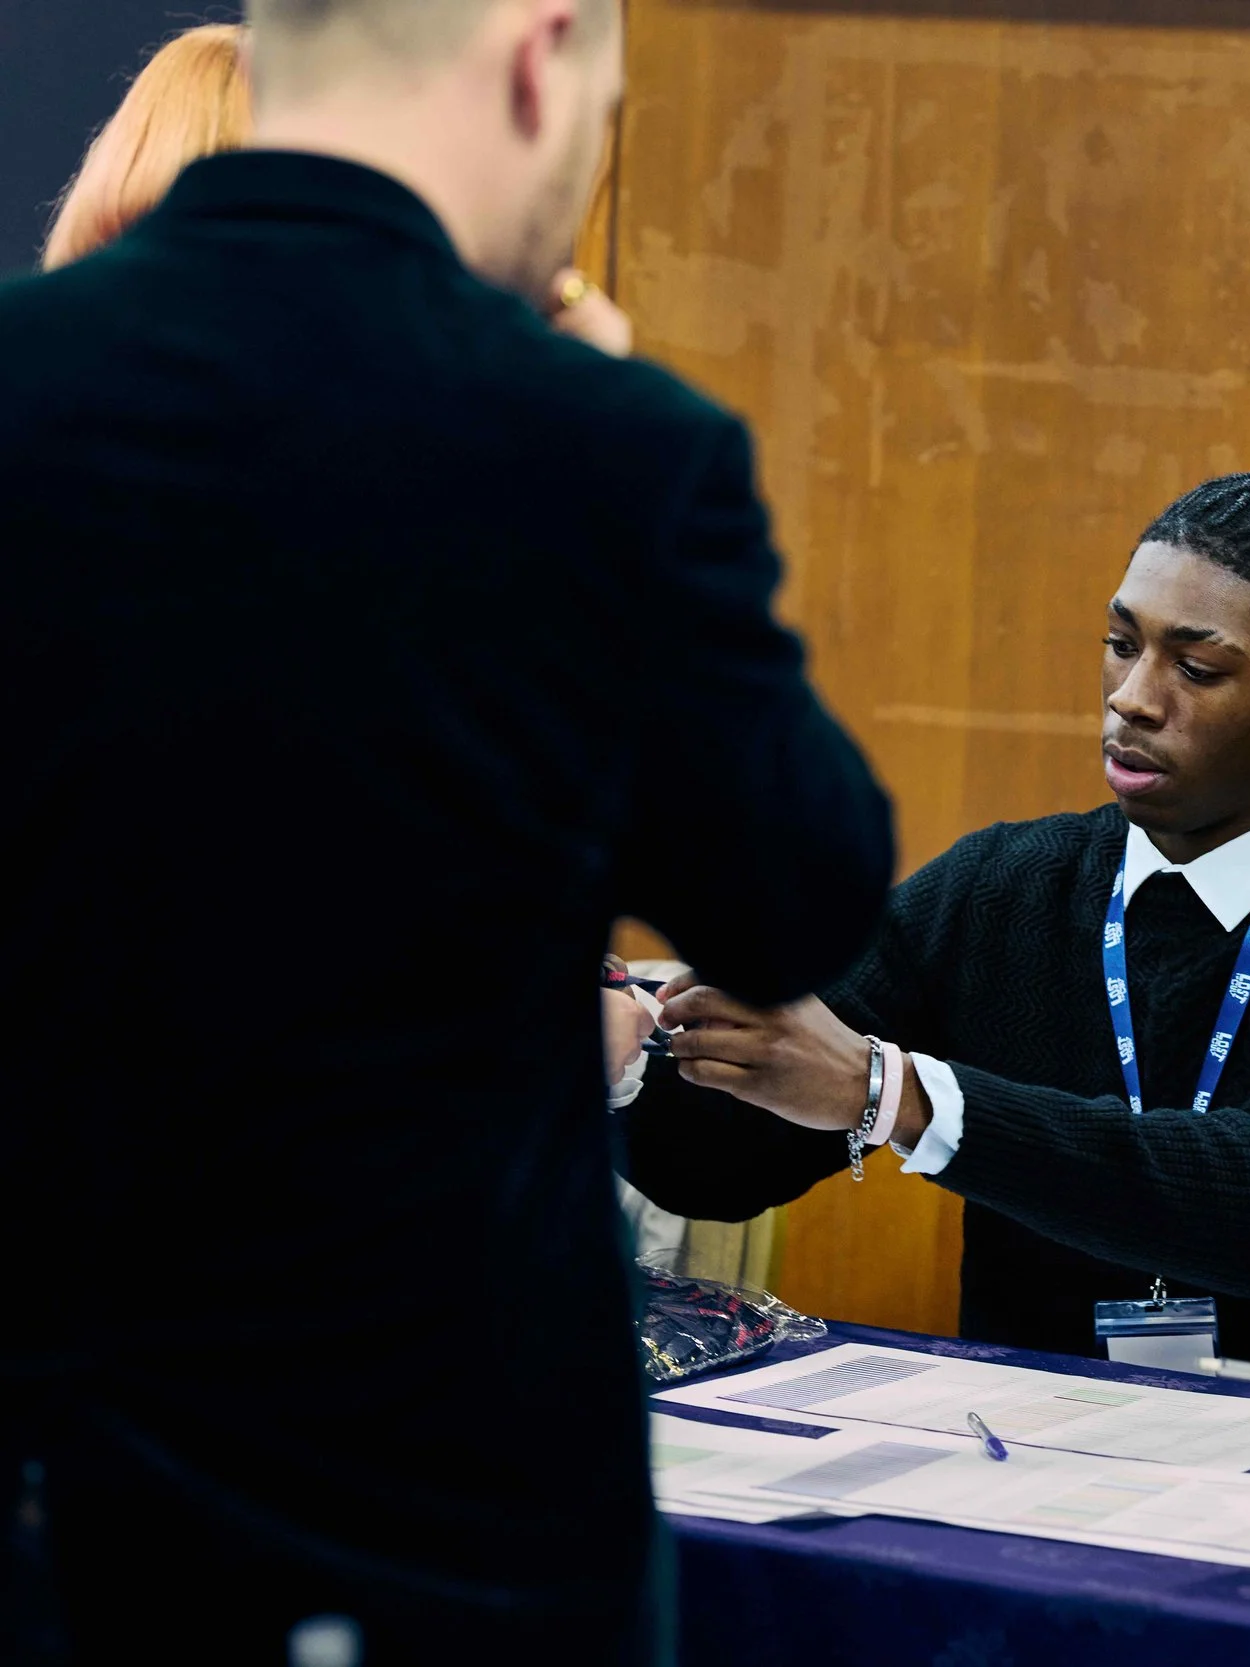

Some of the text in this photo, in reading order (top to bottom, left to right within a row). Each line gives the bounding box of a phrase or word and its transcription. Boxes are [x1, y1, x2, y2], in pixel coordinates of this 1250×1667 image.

[1104, 922, 1118, 949] LOST
[1107, 977, 1123, 1007] LOST
[1117, 1036, 1133, 1065] LOST
[1215, 1032, 1233, 1063] LOST
[1197, 1091, 1211, 1114] LOS
